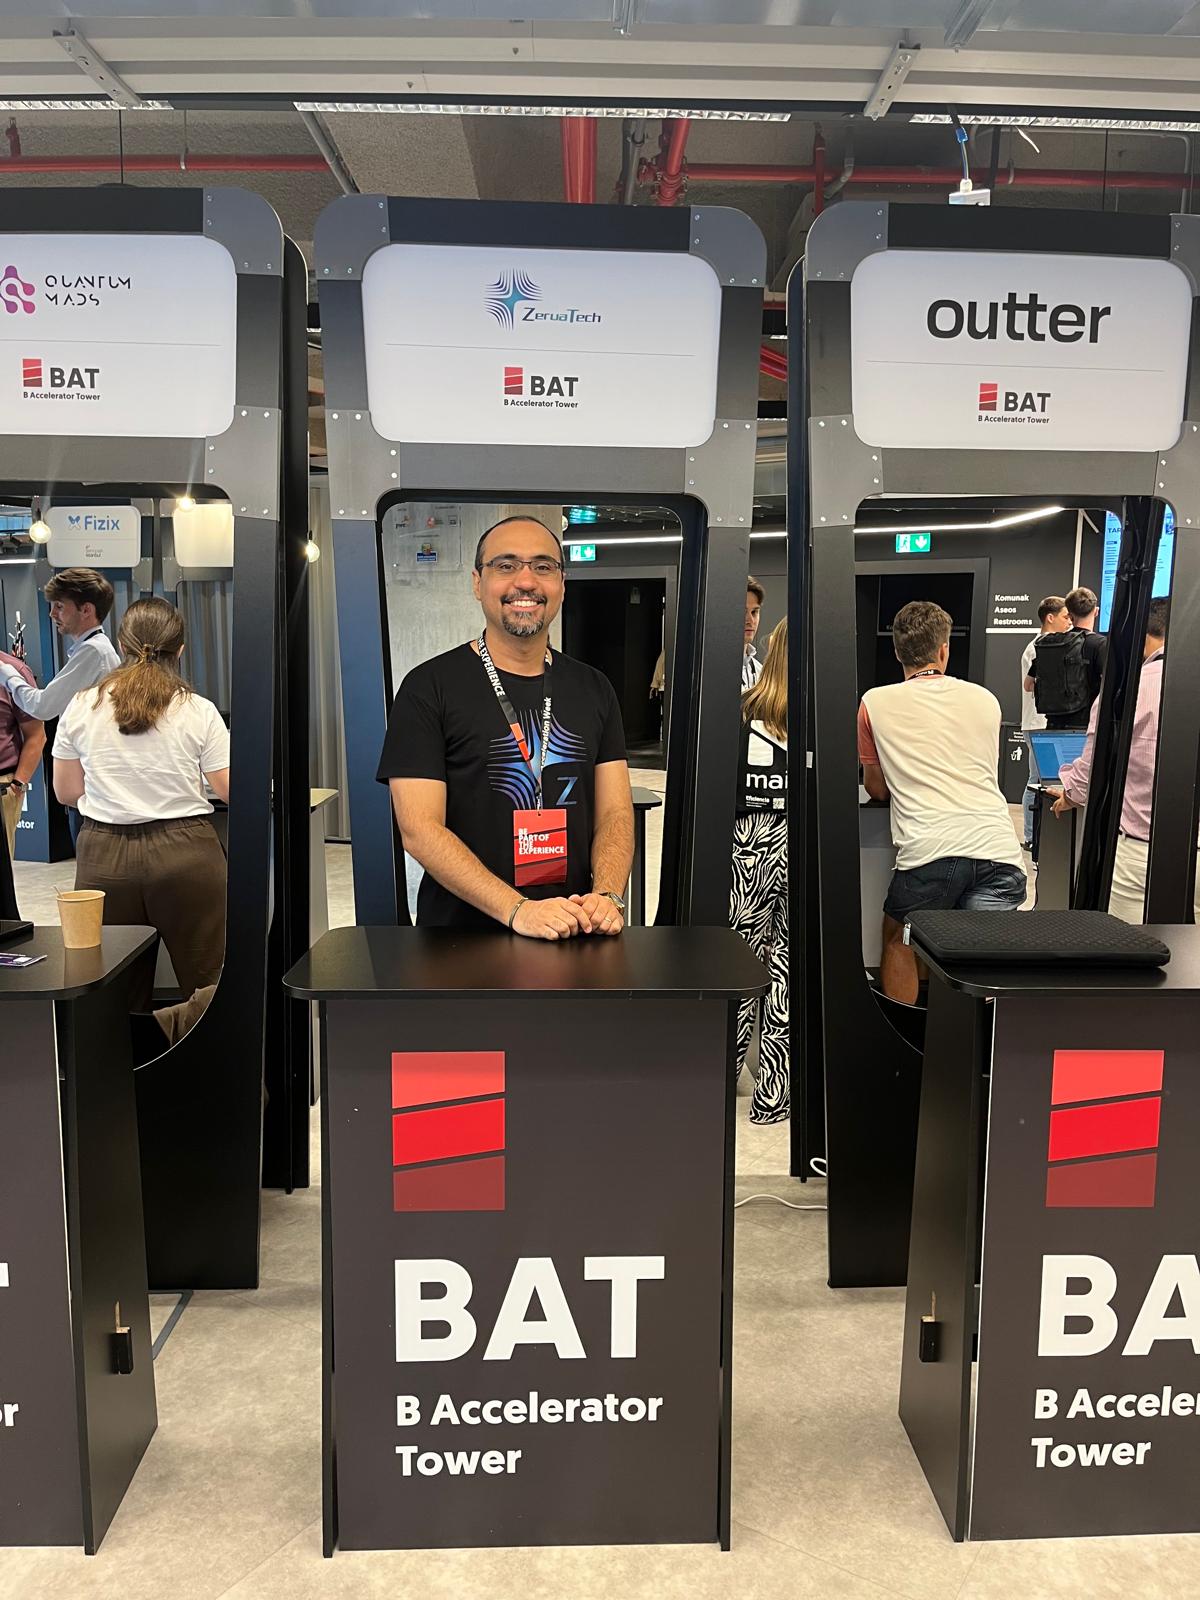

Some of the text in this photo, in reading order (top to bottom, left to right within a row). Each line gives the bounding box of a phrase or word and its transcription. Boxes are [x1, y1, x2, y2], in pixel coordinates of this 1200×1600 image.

[45, 274, 131, 289] QUANTUM
[45, 293, 100, 306] MADS
[521, 307, 601, 323] ZeruaTech
[927, 292, 1112, 344] outter
[50, 366, 100, 389] BAT
[530, 375, 579, 397] BAT
[23, 391, 101, 401] B Accelerator Tower
[510, 399, 554, 408] Accelerator
[554, 400, 579, 408] Tower
[1004, 391, 1051, 413] BAT
[984, 415, 1026, 424] Accelerator
[1027, 416, 1050, 424] Tower
[84, 515, 120, 531] Fizix
[994, 594, 1030, 602] Komunak
[994, 606, 1017, 614] Aseos
[480, 647, 506, 697] EXPERIENCE
[543, 696, 552, 719] Week
[556, 776, 579, 806] Z
[519, 846, 565, 855] EXPERIENCE
[394, 1255, 665, 1362] BAT
[396, 1391, 664, 1426] B Accelerator
[1034, 1388, 1059, 1420] B
[395, 1445, 522, 1477] Tower
[1031, 1437, 1152, 1468] Tower
